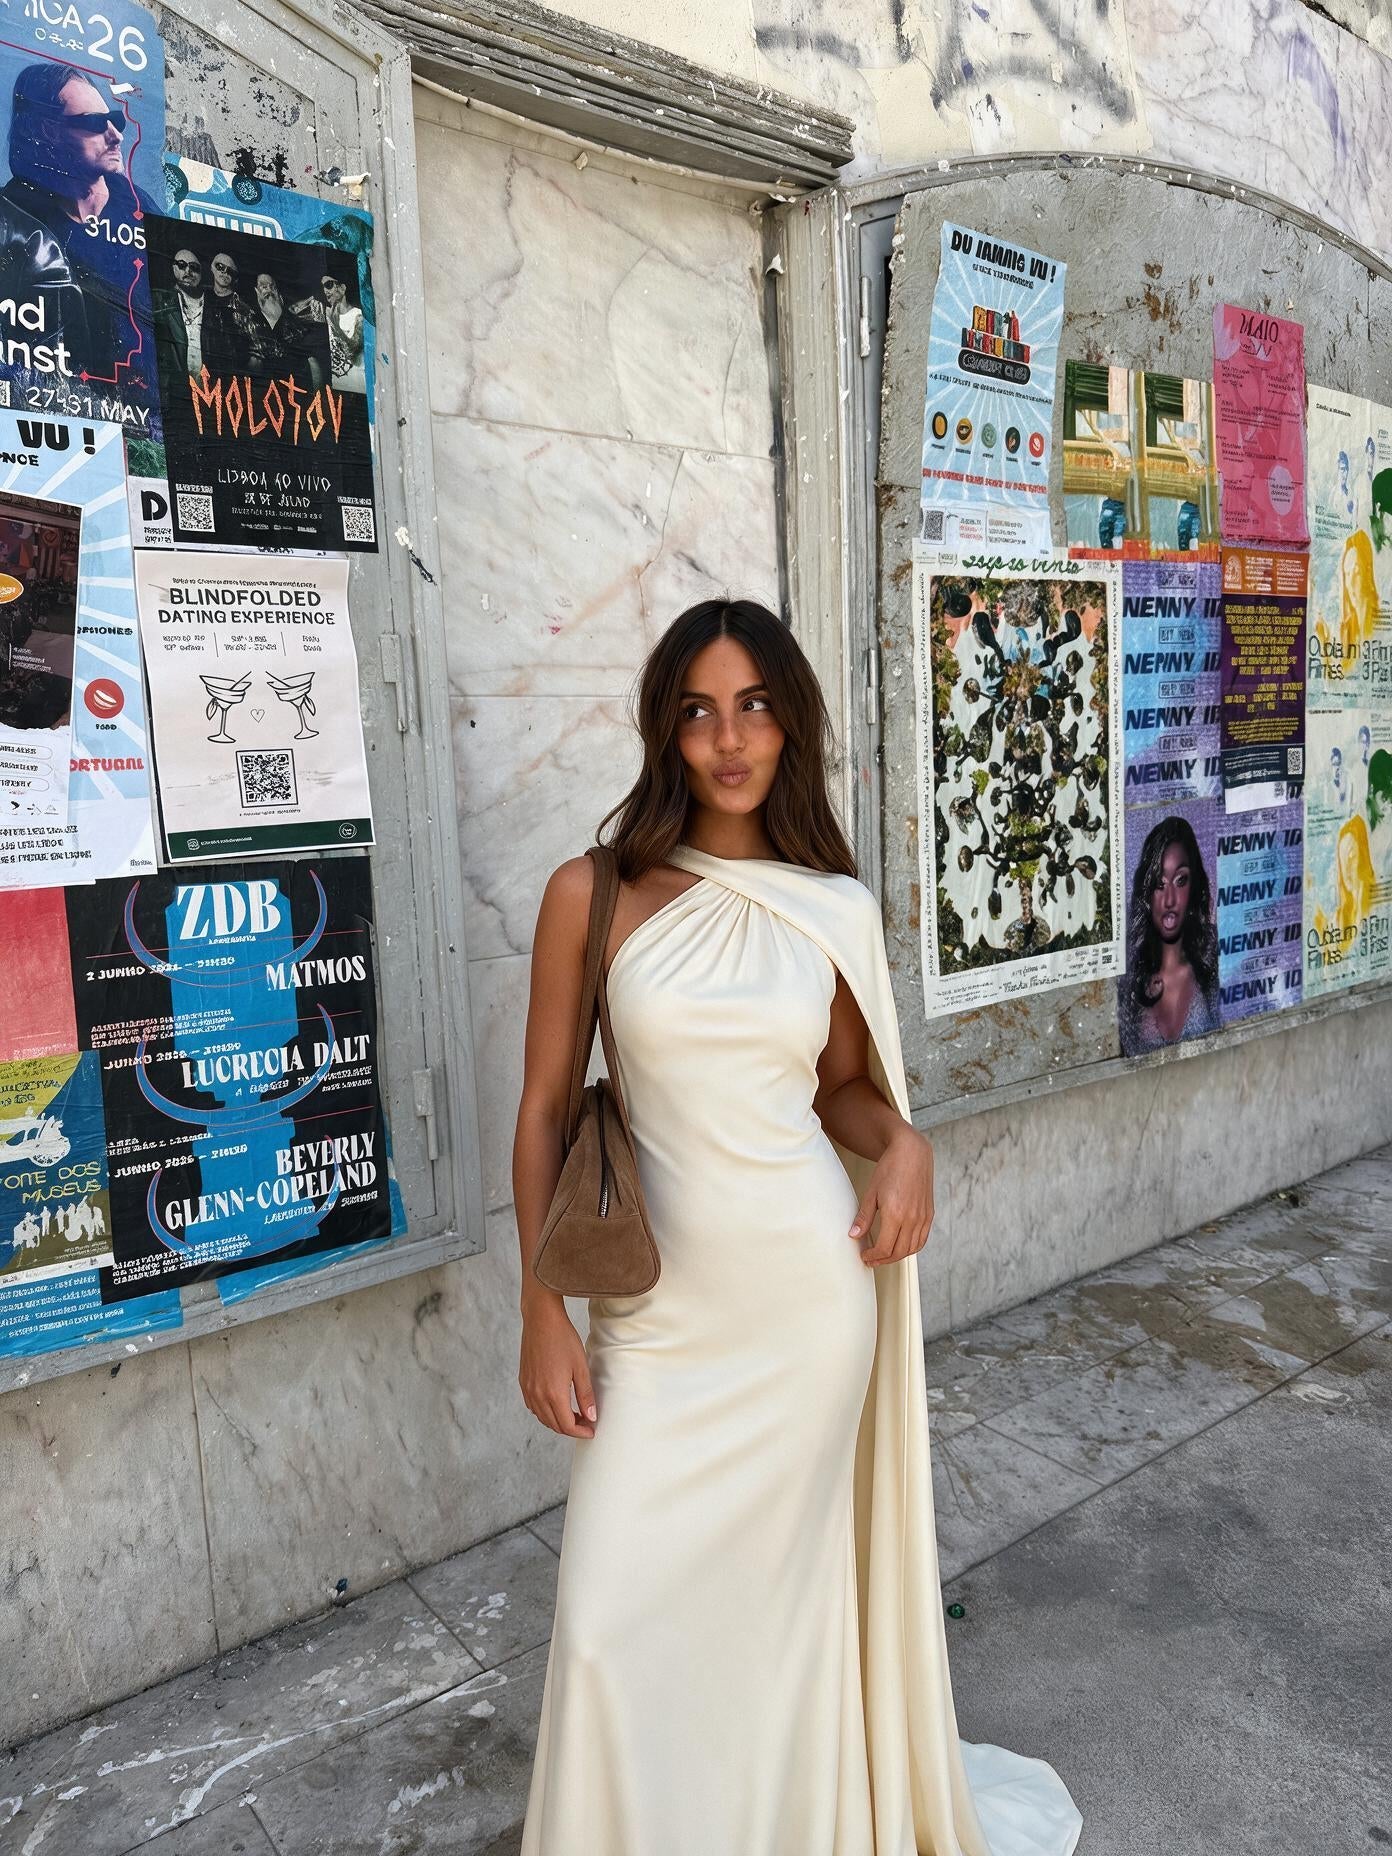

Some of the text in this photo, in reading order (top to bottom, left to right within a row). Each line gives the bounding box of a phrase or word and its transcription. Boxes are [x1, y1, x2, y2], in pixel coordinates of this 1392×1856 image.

[87, 13, 148, 71] 26
[85, 214, 146, 249] 31.05
[951, 230, 973, 255] DU
[1239, 312, 1279, 343] MAIO
[0, 338, 75, 378] nst
[100, 401, 150, 427] MAY
[297, 474, 332, 492] VIVO
[169, 587, 321, 607] BLINDFOLDED
[1122, 596, 1197, 618] NENNY
[158, 609, 336, 625] DATING EXPERIENCE
[1124, 652, 1195, 675] NENNY
[1125, 706, 1197, 731] NENNY
[1126, 758, 1197, 786] NENNY
[1217, 830, 1277, 857] NENNY
[1217, 878, 1277, 908] NENNY
[176, 880, 282, 941] ZDB
[1217, 927, 1278, 957] NENNY
[265, 955, 368, 992] MATMOS
[1217, 974, 1278, 1006] NENNY
[181, 1046, 305, 1089] LUCRECIA
[313, 1034, 371, 1068] DALT
[275, 1131, 376, 1176] BEVERLY
[164, 1161, 378, 1230] GLENN-COPELAND
